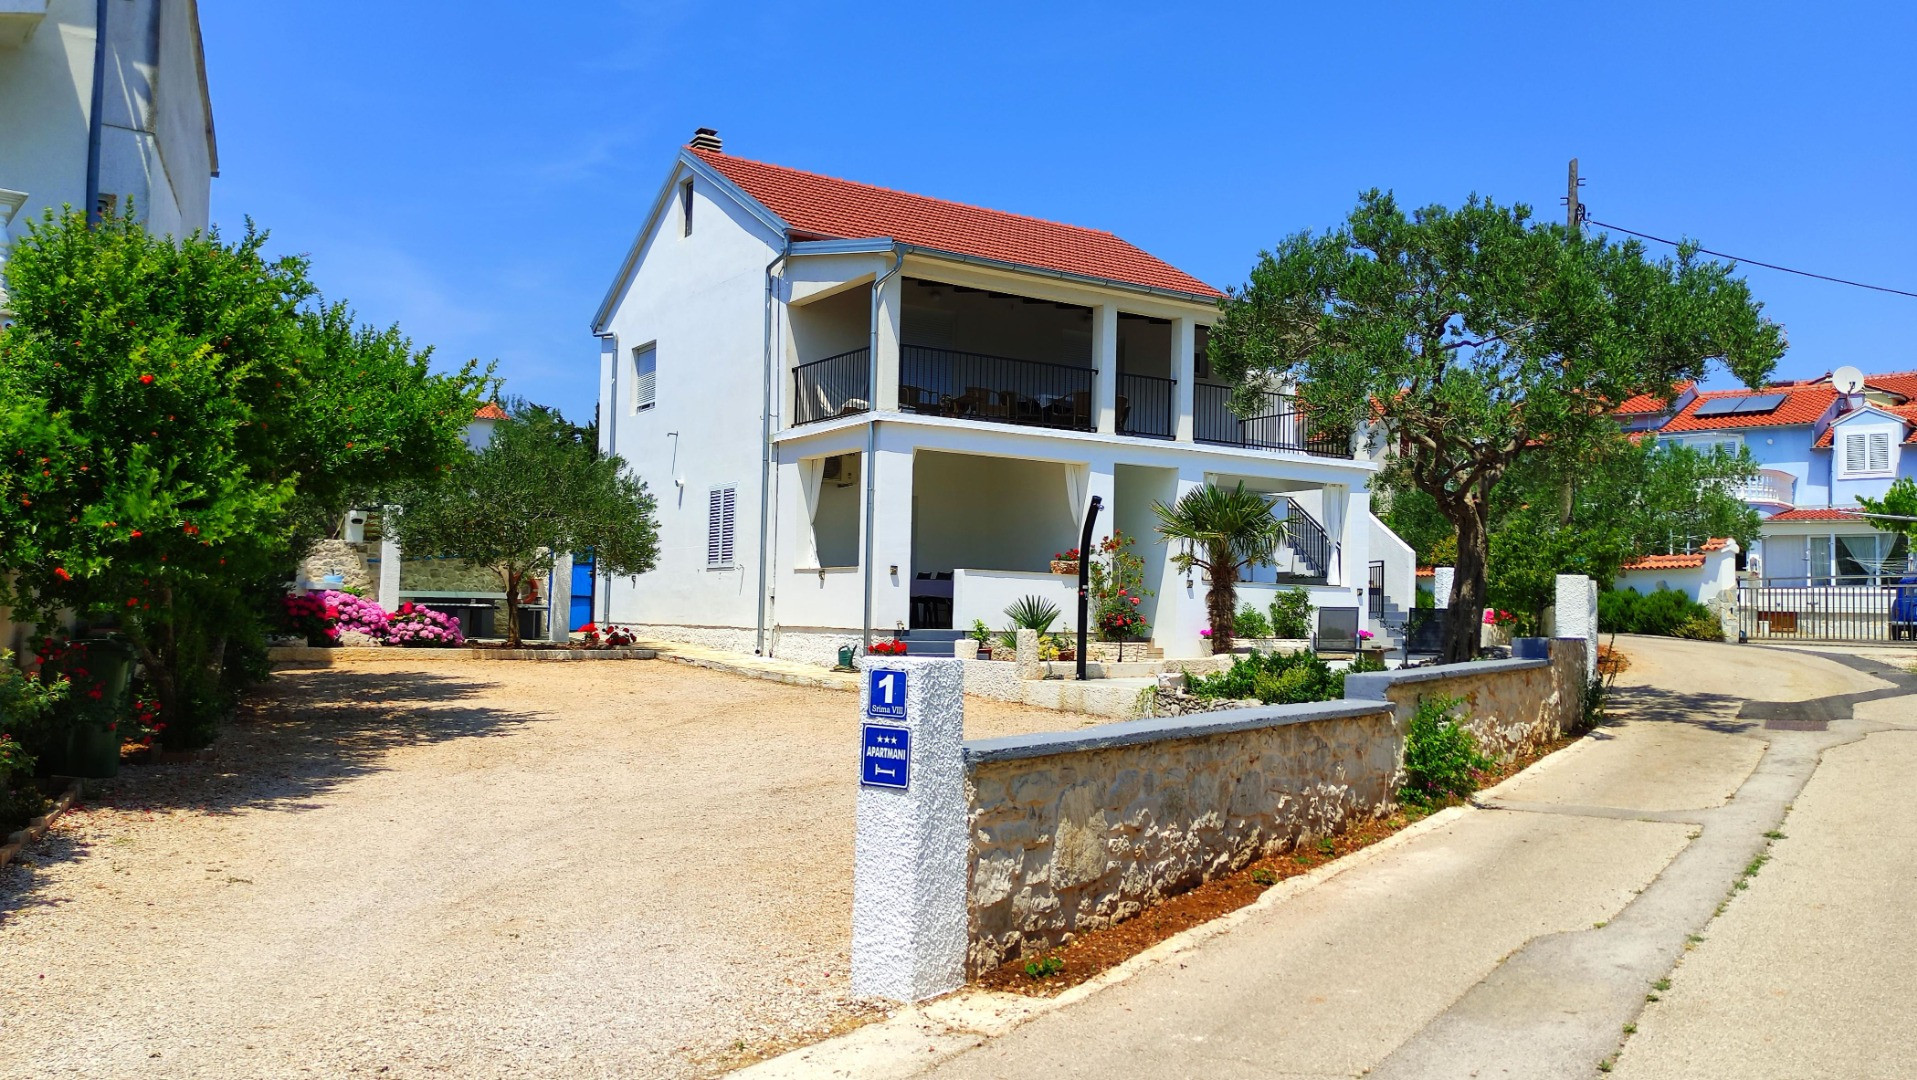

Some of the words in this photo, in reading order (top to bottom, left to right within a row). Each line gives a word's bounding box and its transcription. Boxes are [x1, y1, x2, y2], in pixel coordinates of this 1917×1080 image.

[878, 674, 894, 704] 1
[872, 704, 890, 713] Srima
[892, 706, 904, 715] VIII
[866, 746, 906, 761] APARTMANI
